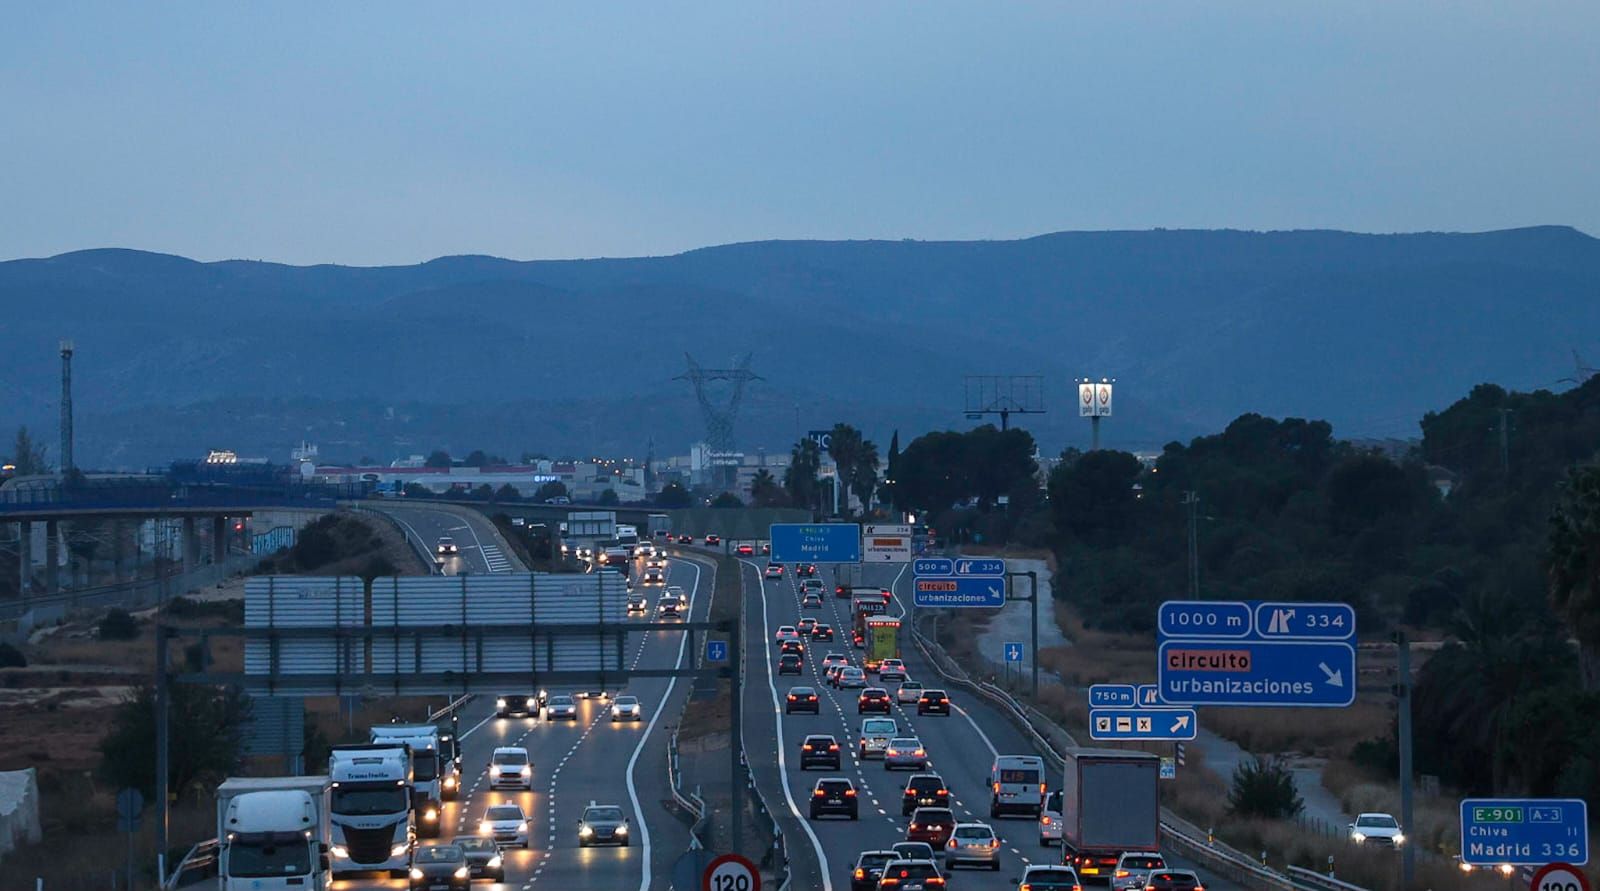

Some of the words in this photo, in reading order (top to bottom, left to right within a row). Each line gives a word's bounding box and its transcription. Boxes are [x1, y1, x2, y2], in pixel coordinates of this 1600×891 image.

[801, 544, 829, 552] Madrid
[918, 582, 956, 591] circuito
[918, 593, 986, 602] urbanizaciones
[1169, 612, 1217, 626] 1000
[1227, 615, 1241, 626] m
[1306, 615, 1344, 627] 334
[1169, 652, 1249, 669] circuito
[1170, 677, 1313, 694] urbanizaciones
[1096, 692, 1117, 700] 750
[1475, 809, 1521, 820] E-901
[1532, 810, 1559, 820] A-3
[1470, 826, 1508, 836] Chiva
[1567, 827, 1577, 836] 11
[1470, 843, 1531, 856] Madrid
[1541, 843, 1579, 856] 336
[714, 874, 749, 891] 120
